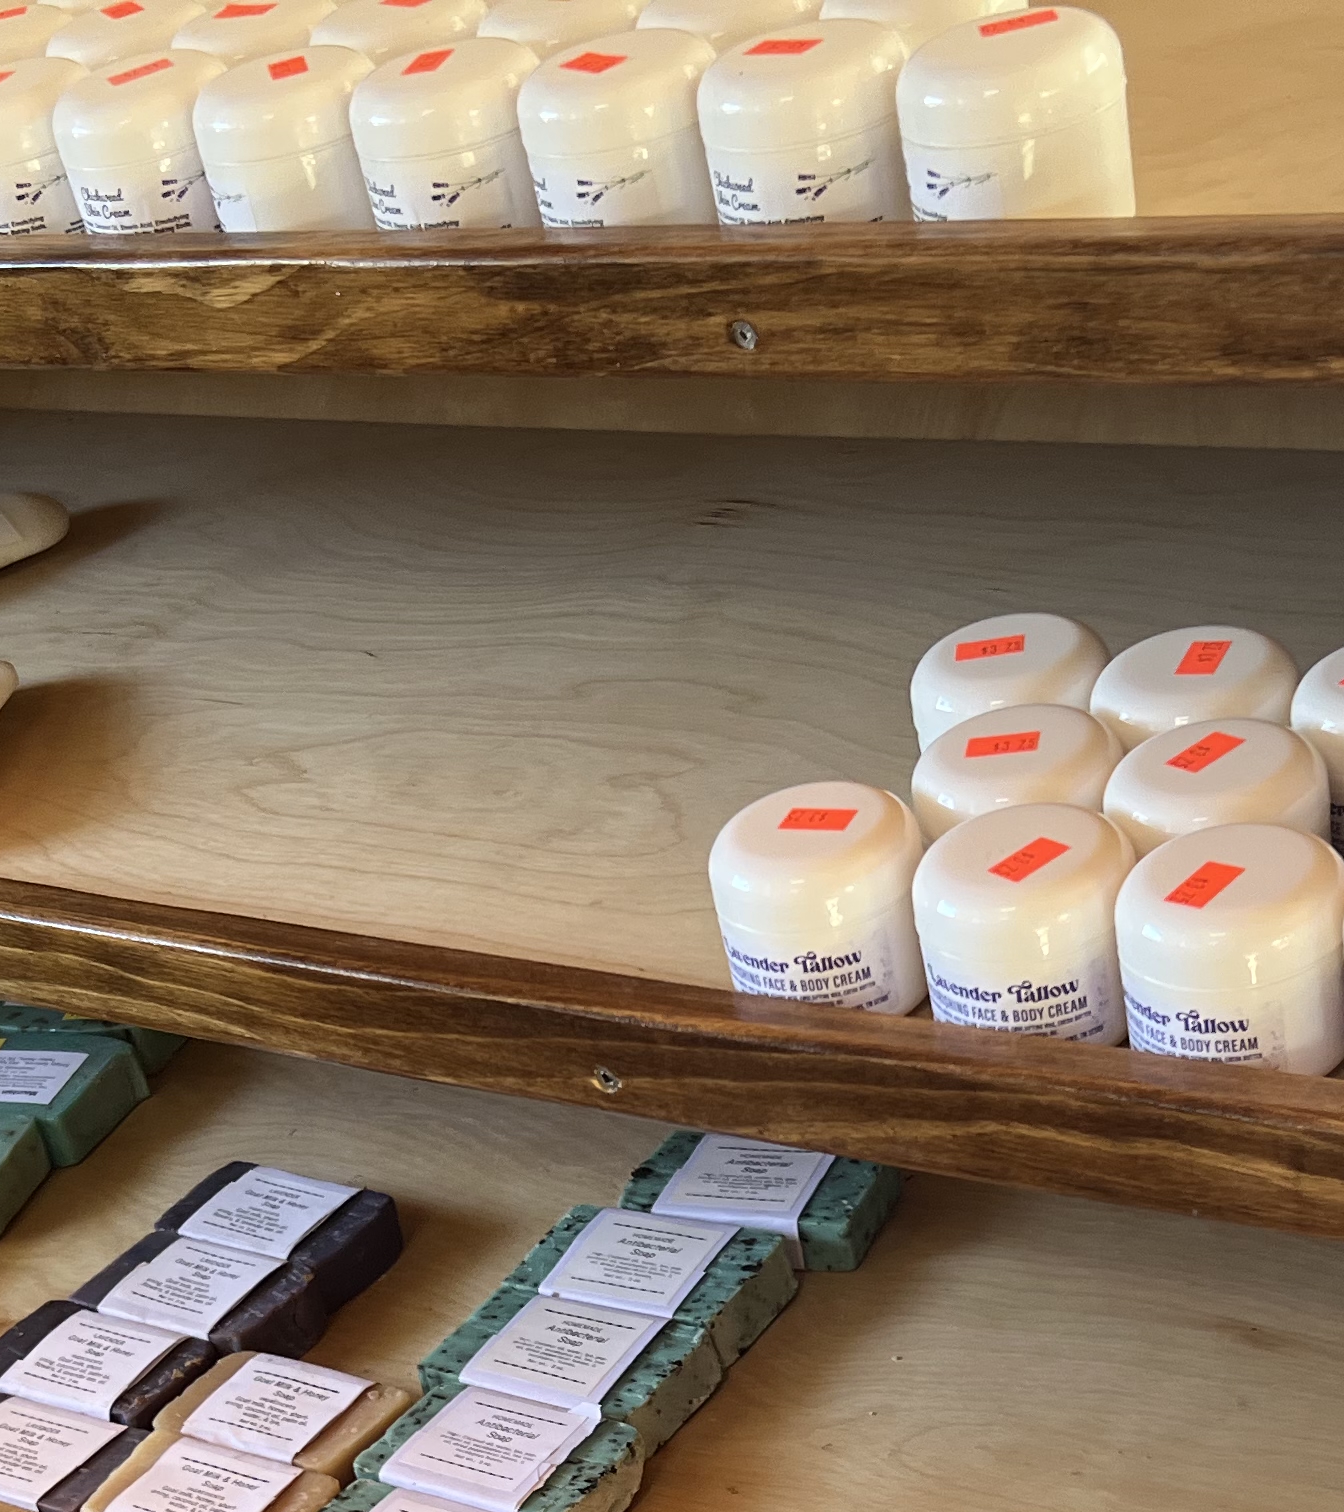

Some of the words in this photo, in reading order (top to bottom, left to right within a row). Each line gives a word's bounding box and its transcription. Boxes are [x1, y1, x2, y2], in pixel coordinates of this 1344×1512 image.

[723, 936, 789, 974] Lavender
[794, 951, 862, 974] Tallow
[763, 976, 787, 992] FACE
[790, 980, 797, 992] &
[800, 978, 830, 992] BODY
[833, 966, 872, 988] CREAM
[928, 963, 1002, 1003] Lavender
[1007, 980, 1079, 1004] Tallow
[972, 1007, 997, 1022] FACE
[1001, 1010, 1009, 1022] &
[1012, 1007, 1045, 1022] BODY
[1048, 996, 1088, 1018] CREAM
